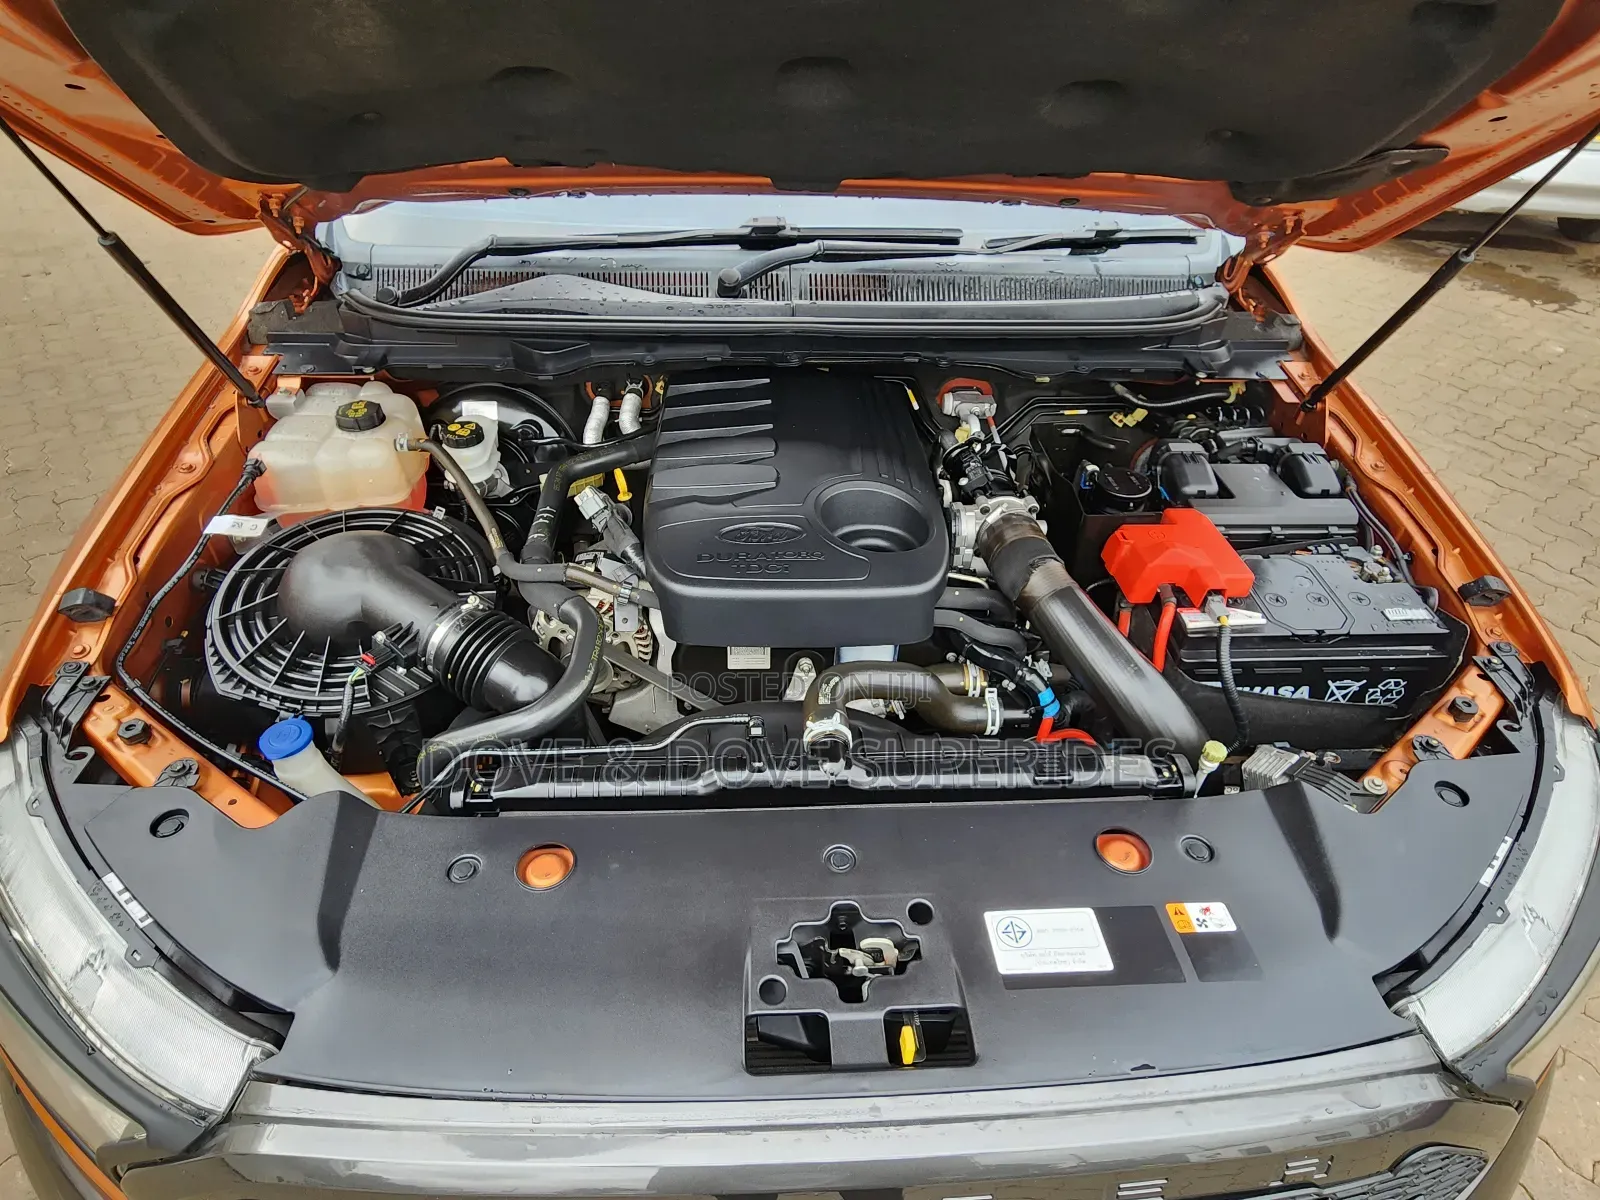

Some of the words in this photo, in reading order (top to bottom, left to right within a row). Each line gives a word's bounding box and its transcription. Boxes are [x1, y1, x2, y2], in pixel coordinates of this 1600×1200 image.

[734, 526, 788, 542] Ford
[697, 551, 825, 564] DURATORQ
[1235, 685, 1310, 699] ASA
